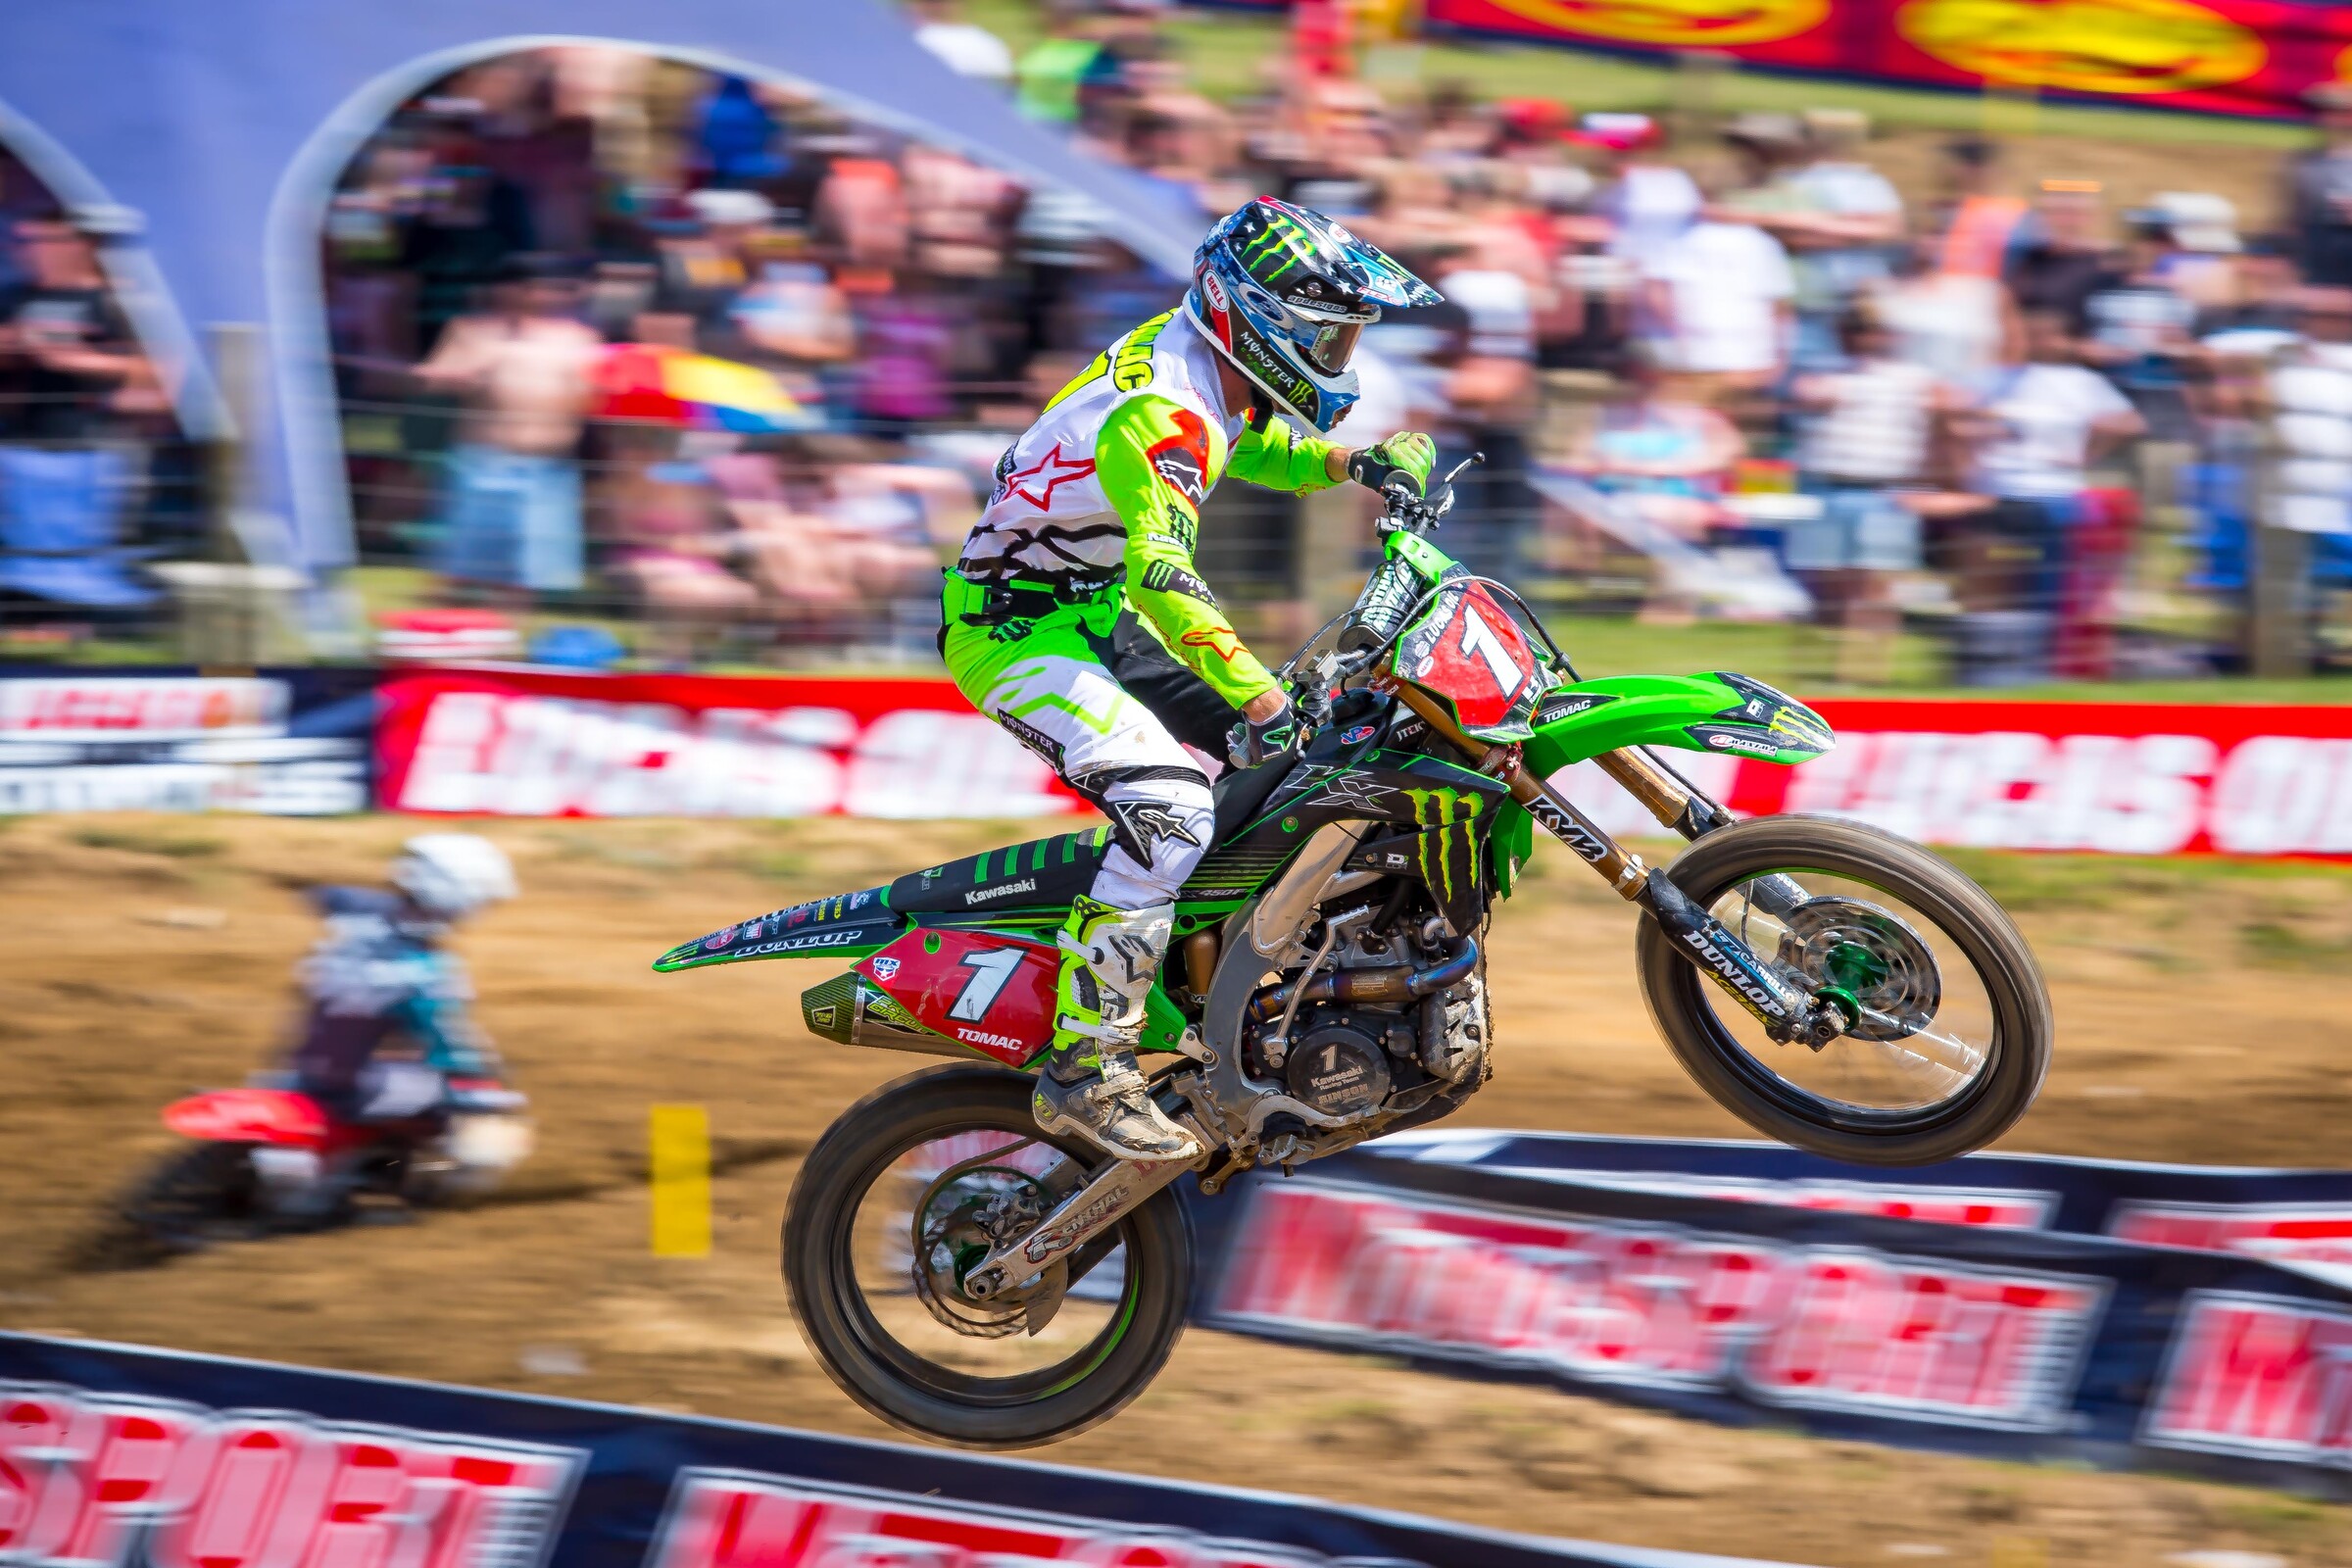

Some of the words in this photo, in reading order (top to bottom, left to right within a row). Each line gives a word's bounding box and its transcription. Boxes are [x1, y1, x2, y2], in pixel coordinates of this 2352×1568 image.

[1204, 273, 1225, 308] BELL
[1240, 330, 1297, 389] MONSTER
[1459, 602, 1525, 701] 1
[1544, 699, 1592, 724] TOMAC
[999, 711, 1055, 754] MONSTER
[1522, 793, 1608, 862] KYB
[964, 877, 1037, 905] Kawasaki
[734, 931, 862, 958] DUNLOP
[946, 946, 1029, 1024] 1
[1683, 930, 1786, 1017] DUNLOP
[1740, 951, 1795, 1004] CARRILLO
[957, 1027, 1023, 1051] TOMAC
[1320, 1044, 1337, 1072] 1
[1310, 1065, 1363, 1088] Kawasaki
